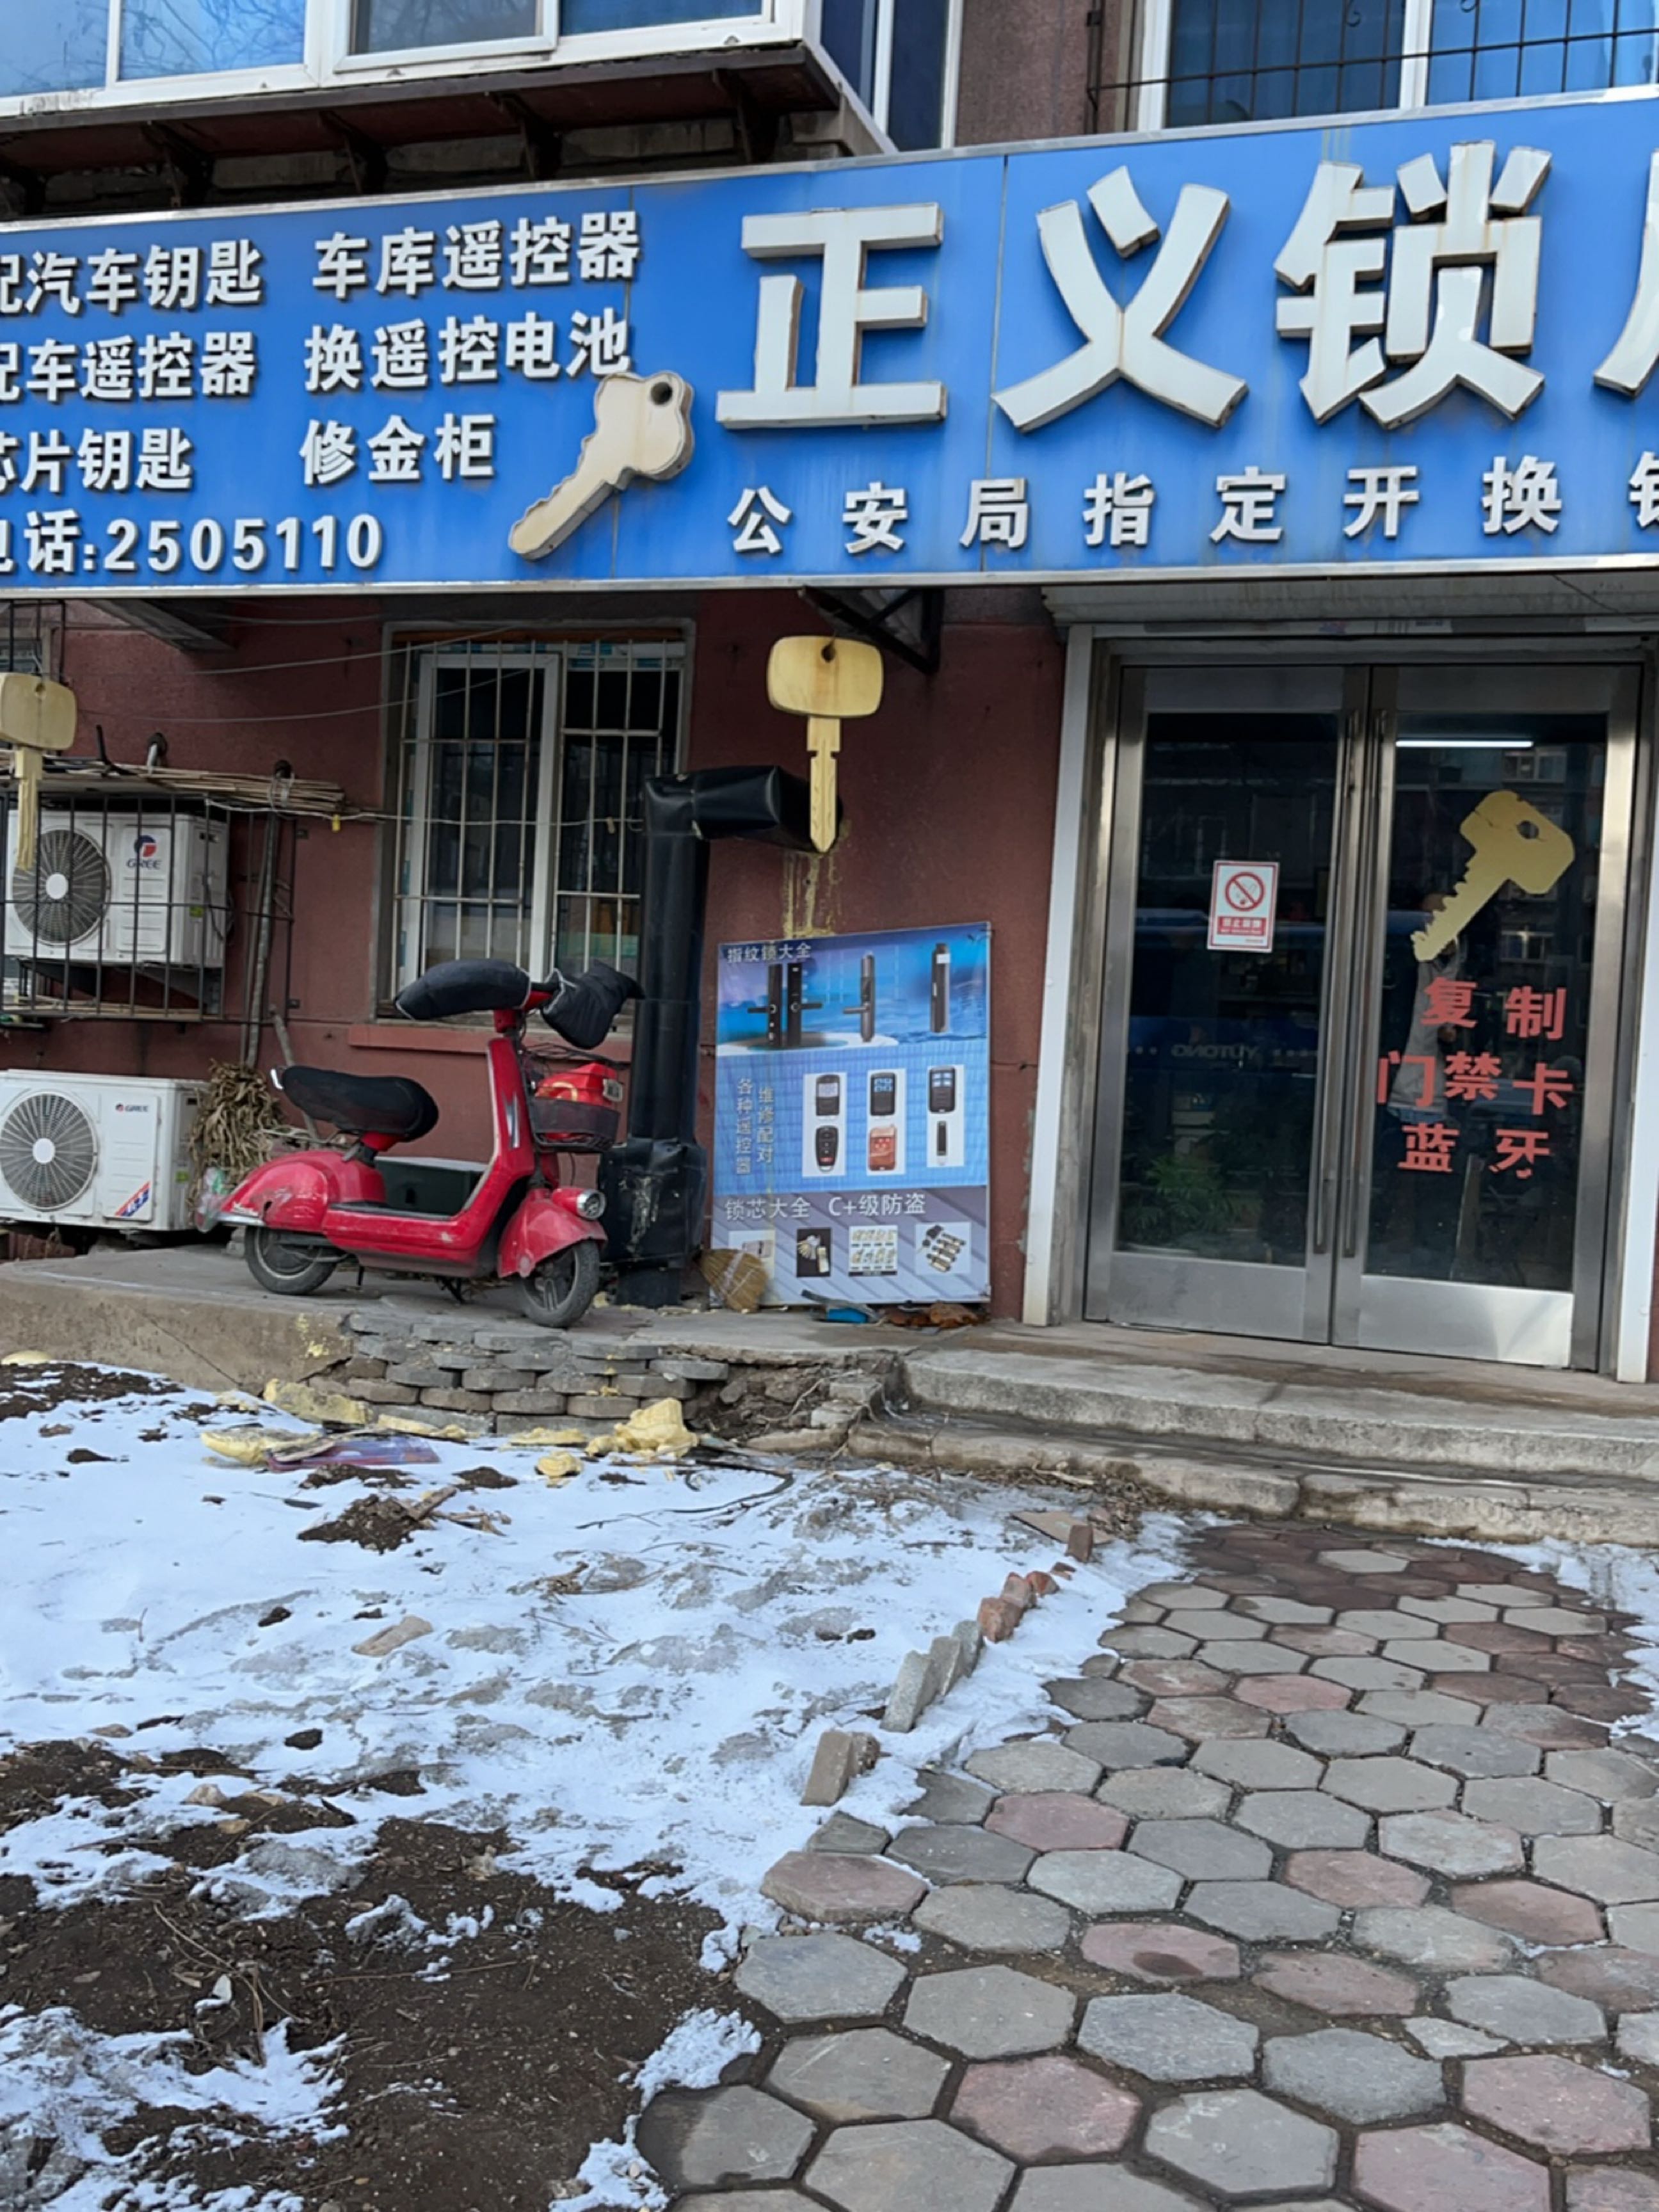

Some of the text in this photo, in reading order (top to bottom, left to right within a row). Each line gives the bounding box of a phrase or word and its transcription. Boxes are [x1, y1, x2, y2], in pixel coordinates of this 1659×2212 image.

[312, 211, 640, 299] 车库遥控器
[716, 140, 1659, 431] 正义锁
[303, 307, 632, 393] 换遥控电池
[299, 413, 497, 486] 修金柜
[0, 509, 382, 572] 话:2505110
[1420, 977, 1567, 1039] 复制
[1377, 1050, 1573, 1114] 门禁卡
[1397, 1122, 1550, 1178] 蓝牙
[725, 1197, 811, 1220] 锁芯大全
[828, 1192, 926, 1216] C+级防盗
